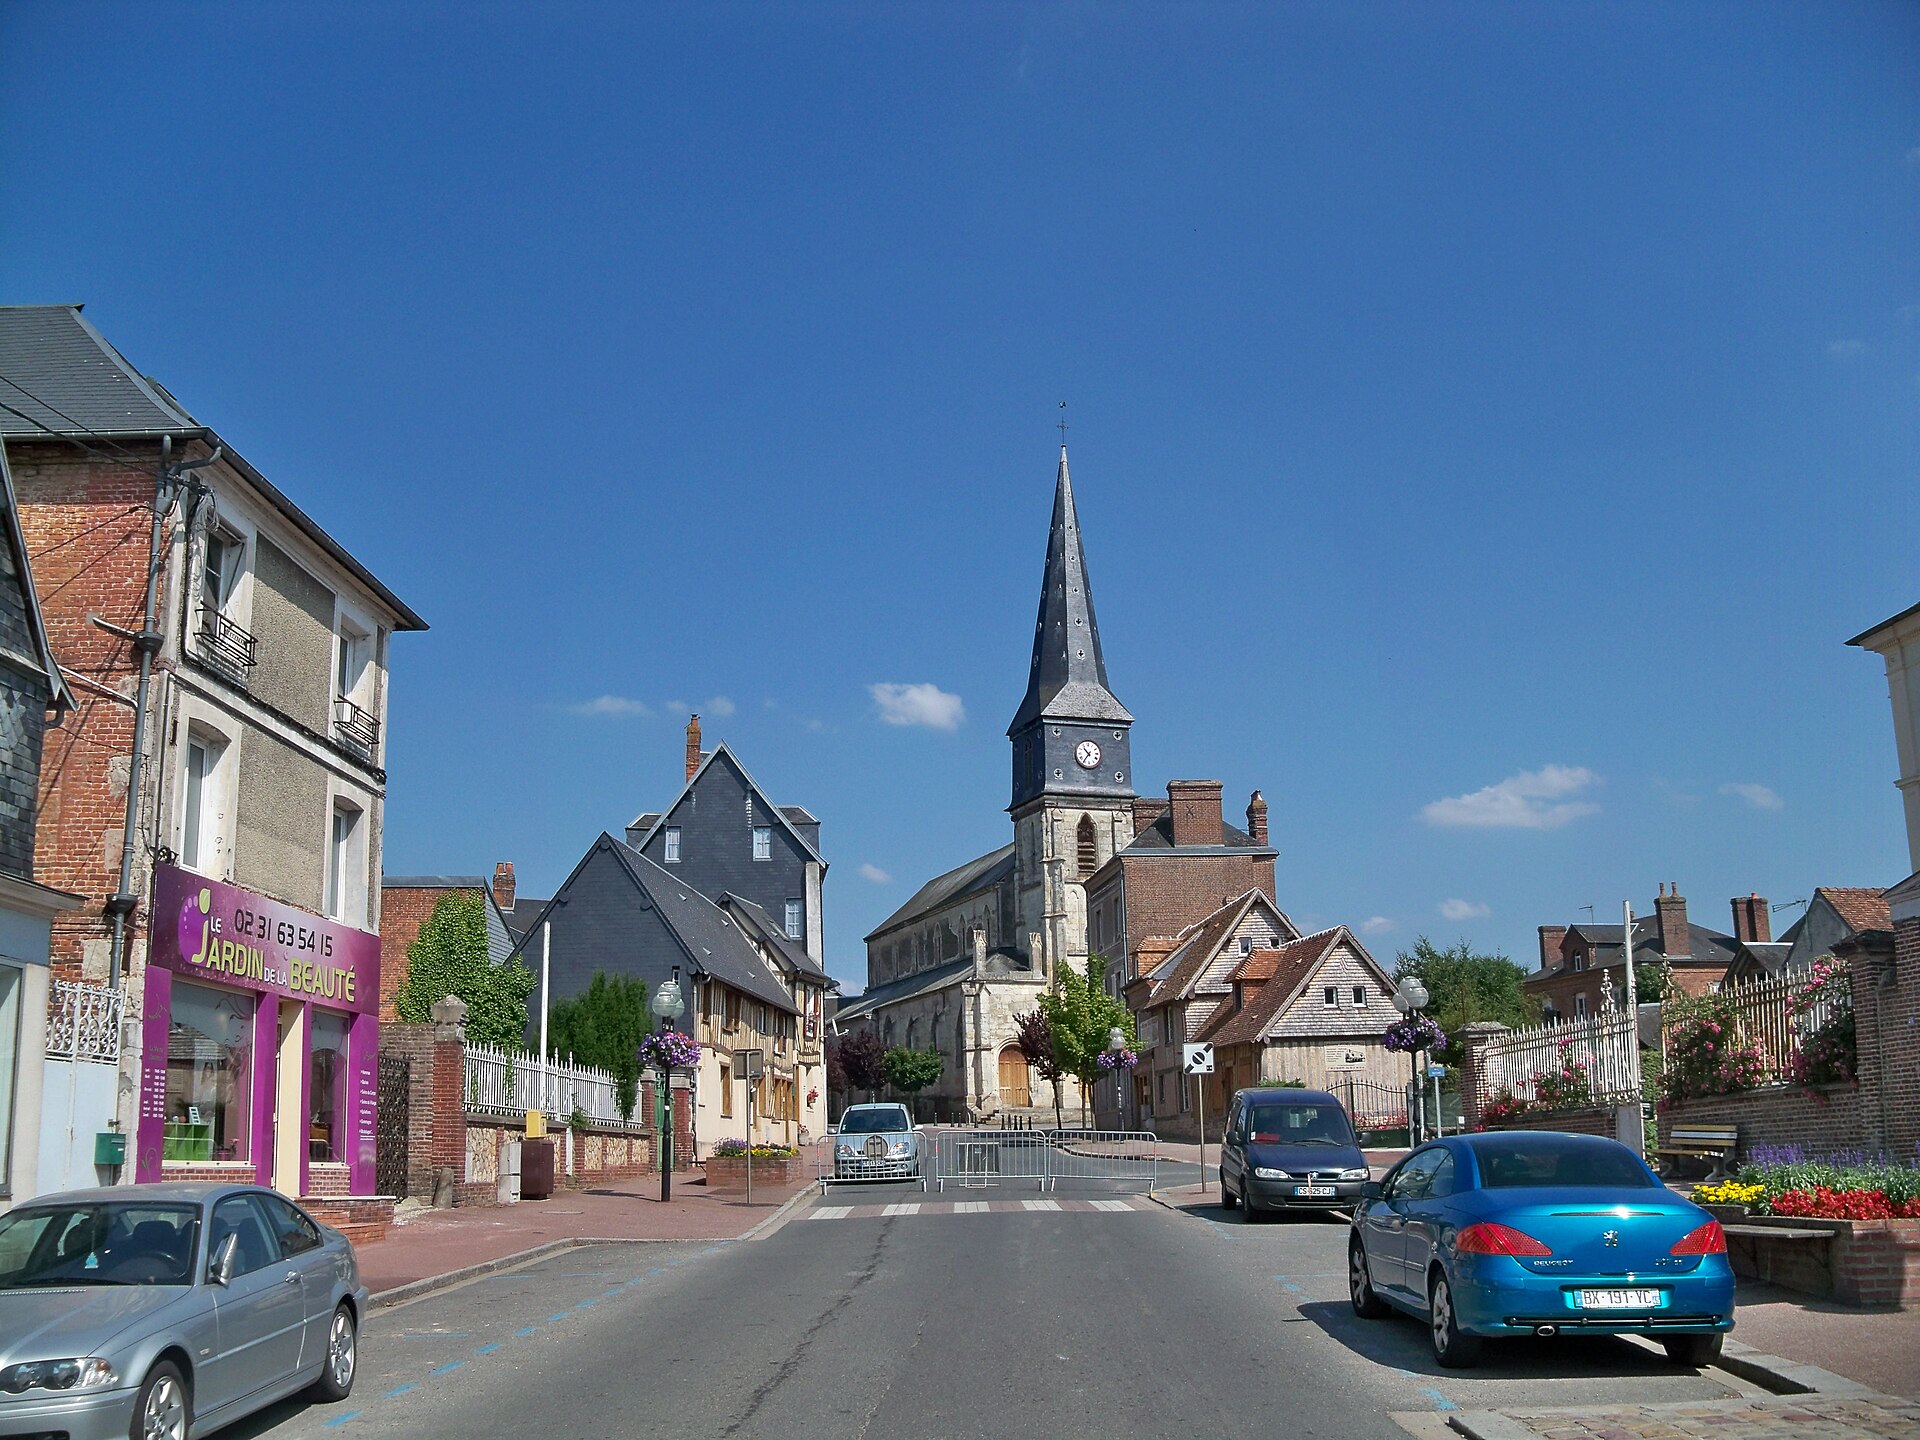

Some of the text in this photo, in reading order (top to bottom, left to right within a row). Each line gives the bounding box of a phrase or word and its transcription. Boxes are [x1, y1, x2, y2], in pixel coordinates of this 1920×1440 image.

[210, 916, 222, 934] LE
[234, 908, 333, 958] 02 31 63 54 15
[192, 919, 356, 1003] JARDIN DE LA BEAUTÉ
